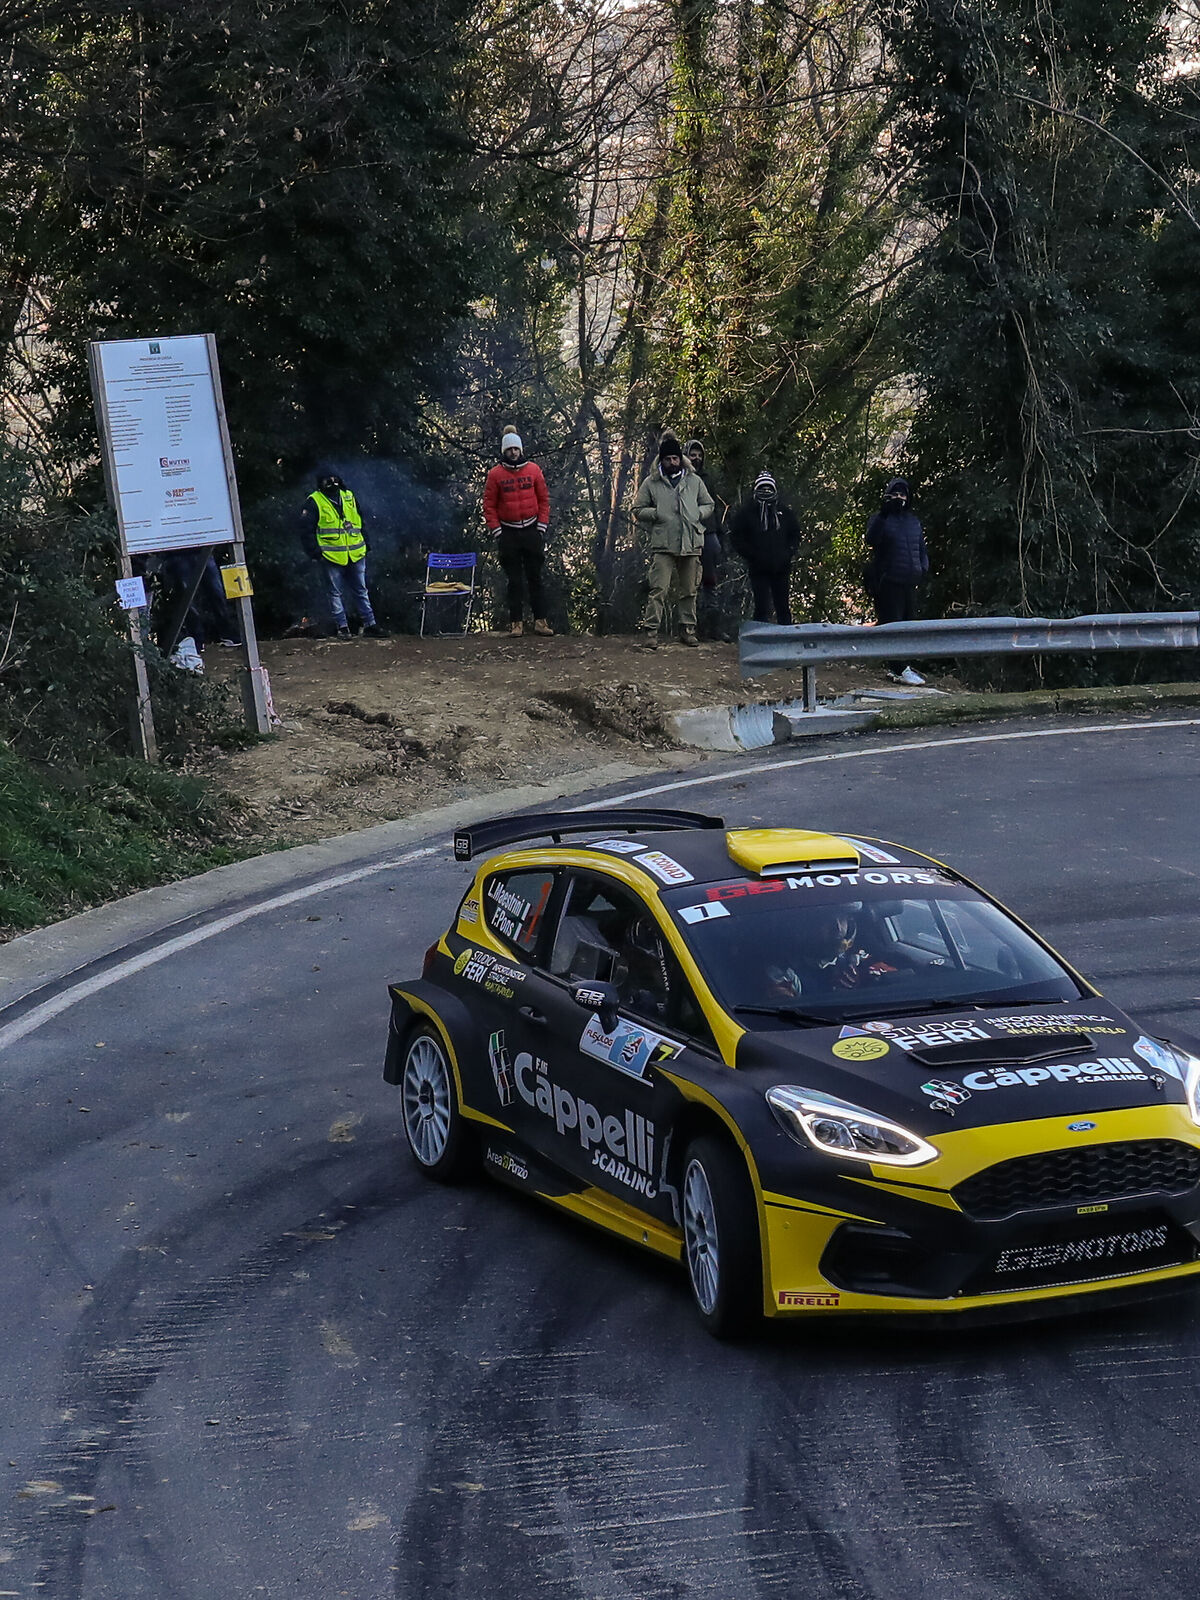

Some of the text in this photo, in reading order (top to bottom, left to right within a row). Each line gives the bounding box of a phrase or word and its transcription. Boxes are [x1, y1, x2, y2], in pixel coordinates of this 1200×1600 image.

[652, 857, 685, 879] CONAD
[705, 873, 935, 902] GB MOTORS
[462, 960, 488, 983] FERI
[892, 1026, 991, 1050] FERI
[962, 1057, 1144, 1092] Cappelli
[1076, 1072, 1150, 1084] SCARLINO
[514, 1052, 654, 1176] Cappelli
[779, 1292, 840, 1306] PIRELLI
